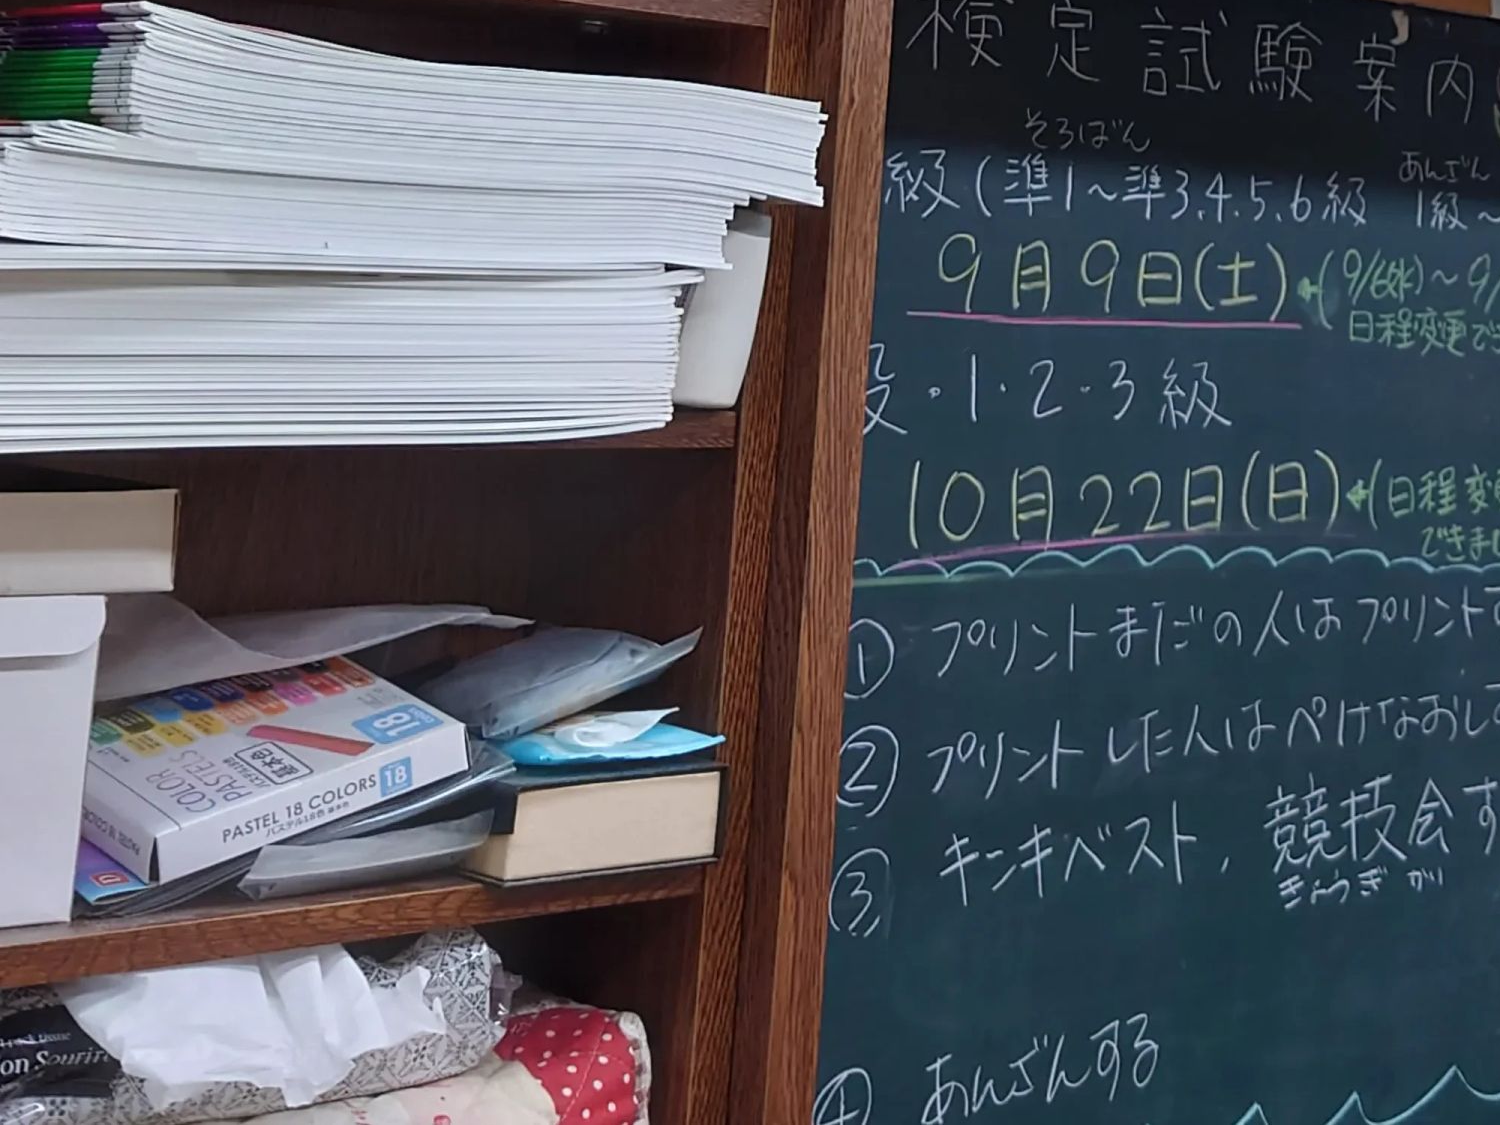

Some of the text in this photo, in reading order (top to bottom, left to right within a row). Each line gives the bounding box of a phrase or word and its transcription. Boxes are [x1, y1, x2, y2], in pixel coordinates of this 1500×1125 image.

[1023, 105, 1152, 153] そろばん
[937, 232, 1287, 322] 9月9日(土)
[908, 449, 1341, 549] 10月22日(日)
[373, 712, 421, 736] 18
[169, 749, 253, 802] PASTELS
[250, 748, 300, 779] 基本色
[385, 765, 408, 788] 18
[145, 768, 216, 813] COLOR
[222, 773, 377, 845] PASTEL 18 COLORS
